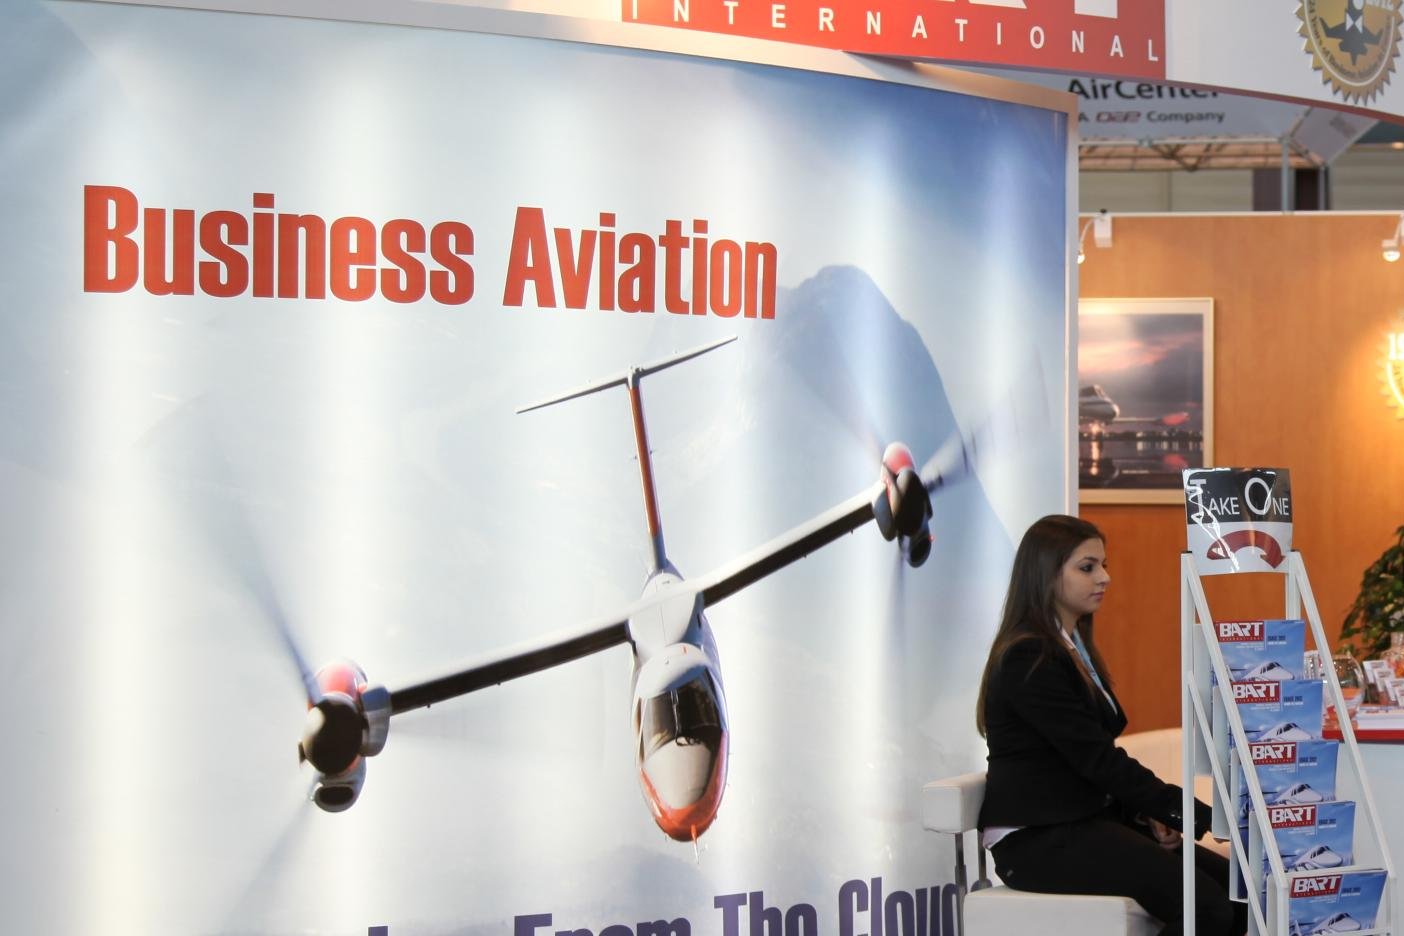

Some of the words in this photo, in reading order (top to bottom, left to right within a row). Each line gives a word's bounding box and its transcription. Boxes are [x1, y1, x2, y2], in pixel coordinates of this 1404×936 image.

[631, 0, 1159, 62] INTERNATIONAL
[1068, 78, 1219, 99] AirCent
[1147, 111, 1225, 123] Company
[84, 184, 475, 306] Business
[503, 206, 778, 320] Aviation
[1190, 478, 1240, 516] TAKE
[1245, 477, 1290, 516] ONE
[1219, 622, 1263, 637] BART
[1232, 682, 1279, 699] BART
[1252, 743, 1296, 760] BART
[1271, 805, 1316, 824] BART
[1293, 876, 1341, 893] BART
